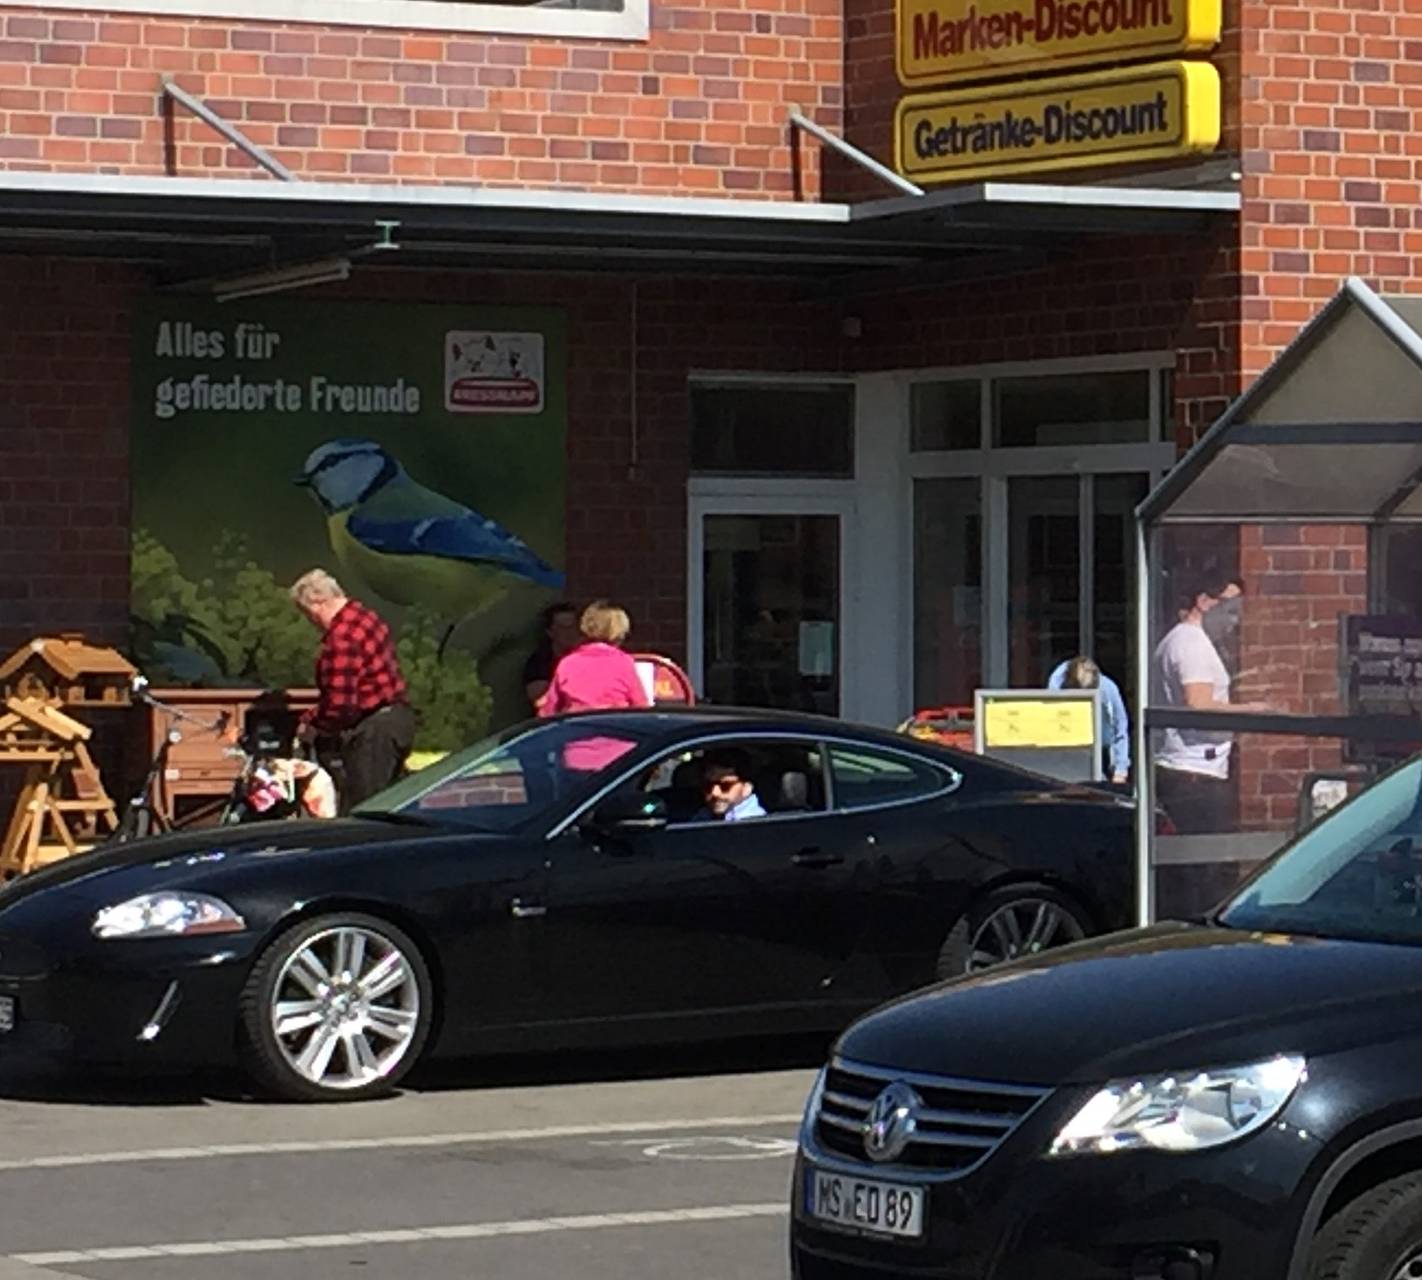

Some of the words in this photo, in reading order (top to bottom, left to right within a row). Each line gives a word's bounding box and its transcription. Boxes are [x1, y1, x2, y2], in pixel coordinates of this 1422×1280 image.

[914, 91, 1169, 160] Getränke-Discount
[156, 321, 225, 358] Alles
[234, 323, 281, 359] für
[155, 374, 301, 418] gefiederte
[310, 376, 421, 413] Freunde
[885, 1188, 912, 1230] 89
